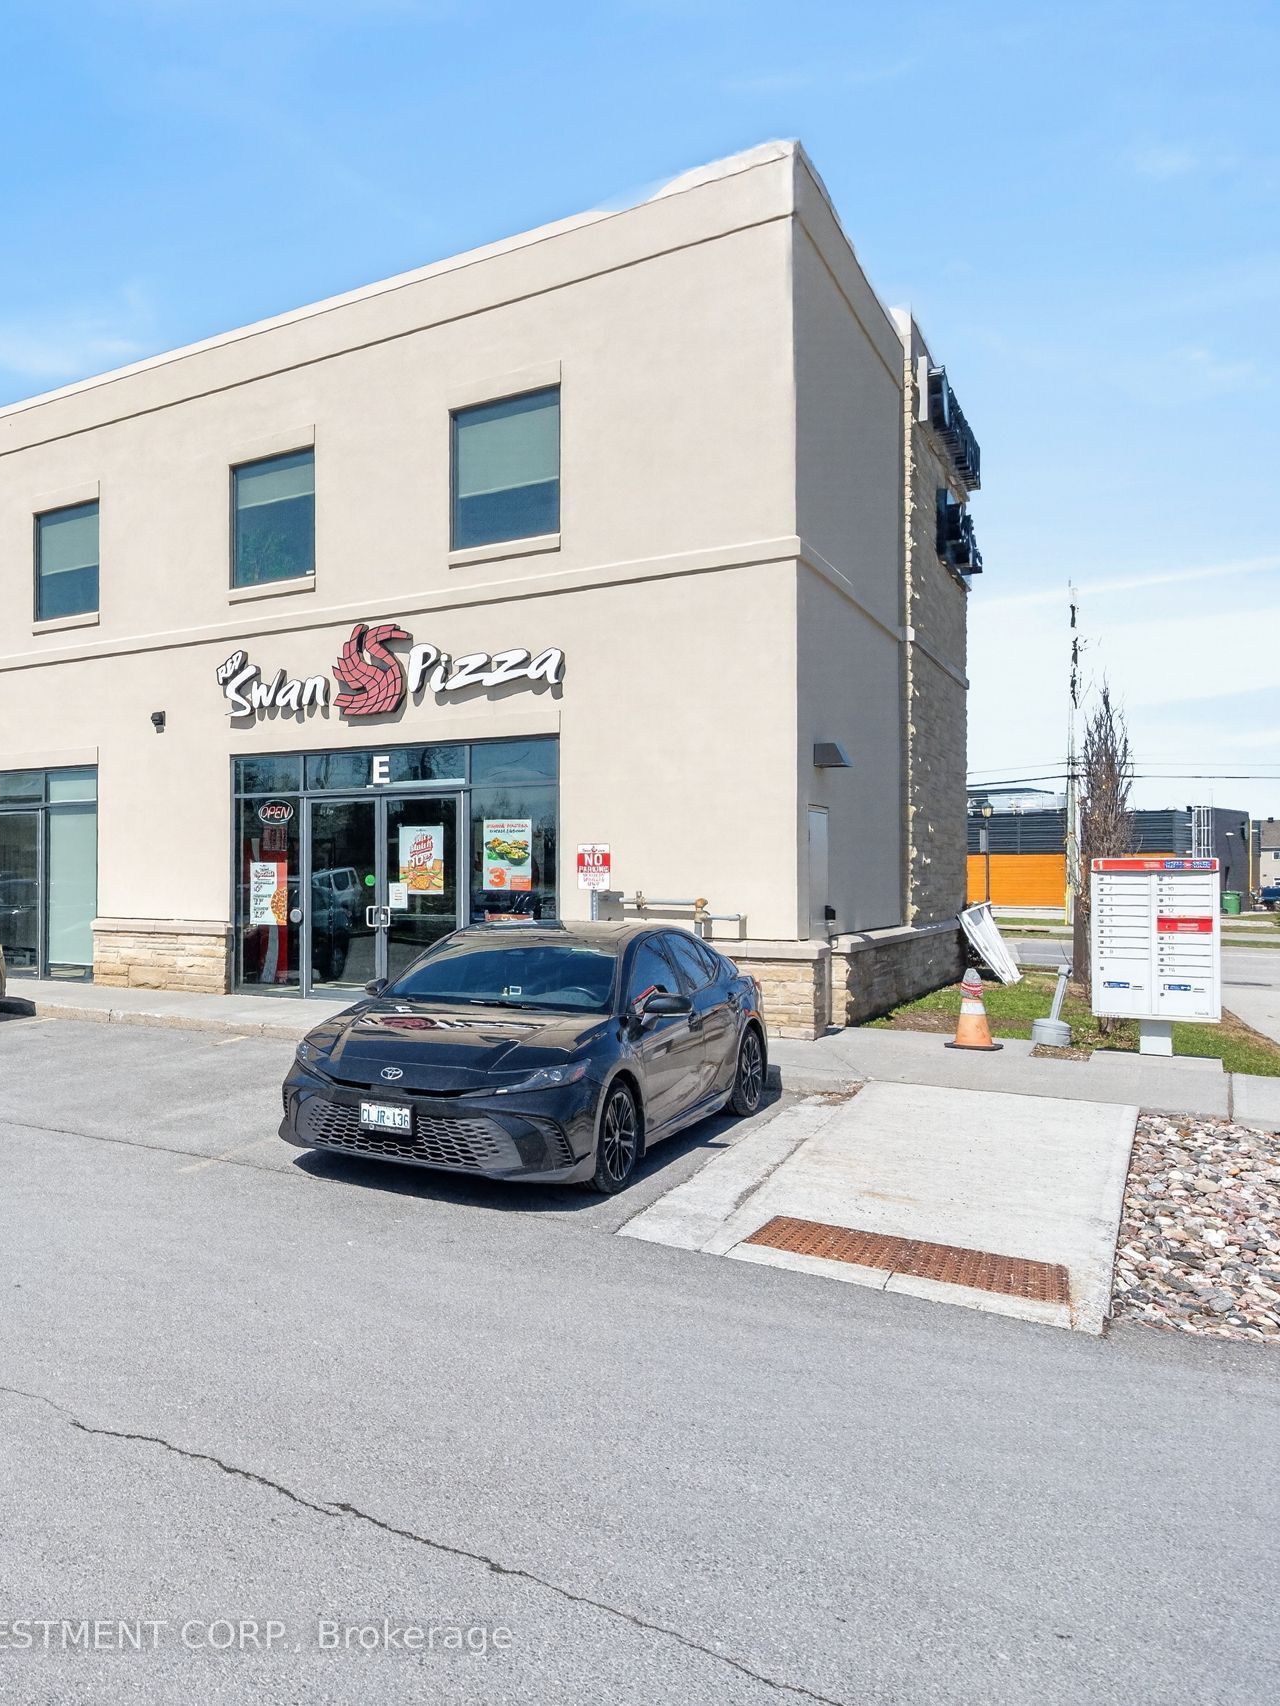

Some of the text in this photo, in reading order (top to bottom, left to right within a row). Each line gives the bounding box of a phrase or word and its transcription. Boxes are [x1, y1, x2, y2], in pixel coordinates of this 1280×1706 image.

[217, 650, 244, 685] RED
[225, 642, 562, 717] Swan Pizza
[372, 755, 391, 784] E
[260, 806, 290, 819] OPEN
[584, 853, 603, 867] NO
[488, 866, 507, 889] 3
